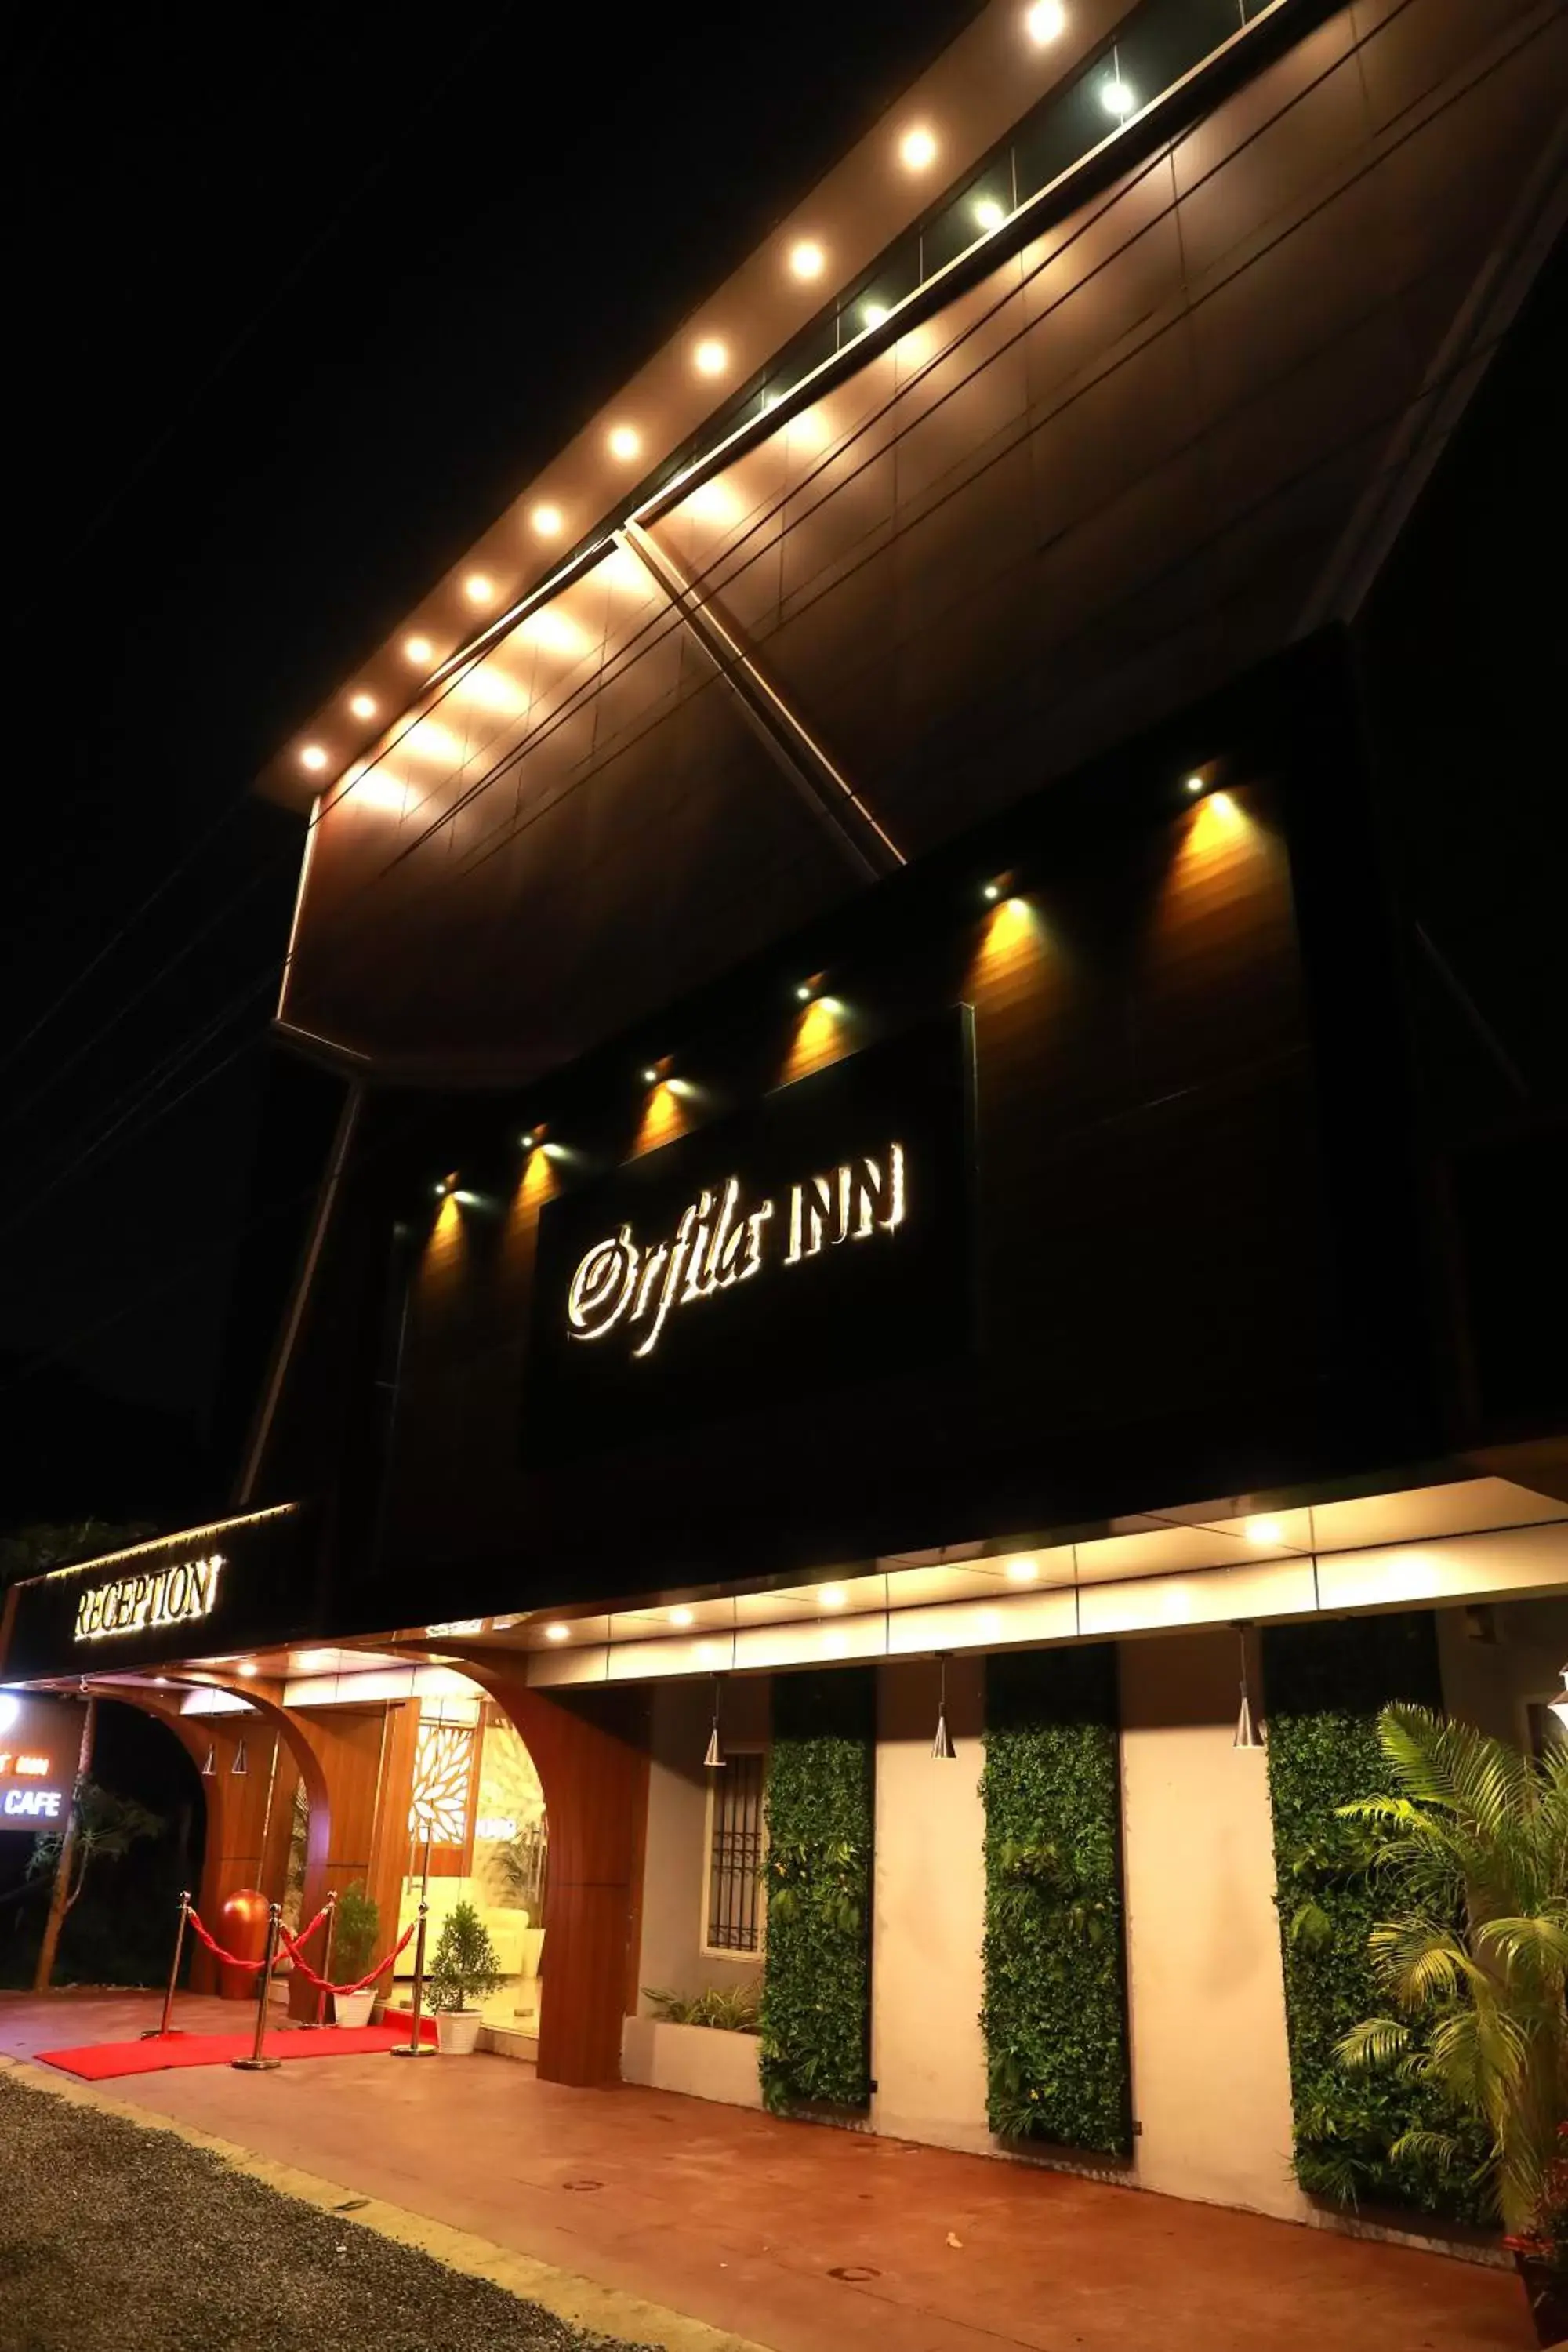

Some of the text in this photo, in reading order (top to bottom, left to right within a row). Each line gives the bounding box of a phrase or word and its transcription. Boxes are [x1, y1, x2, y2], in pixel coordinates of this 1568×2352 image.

[784, 1142, 905, 1264] INN
[74, 1555, 224, 1642] RECEPTION
[4, 1790, 62, 1817] CAFE
